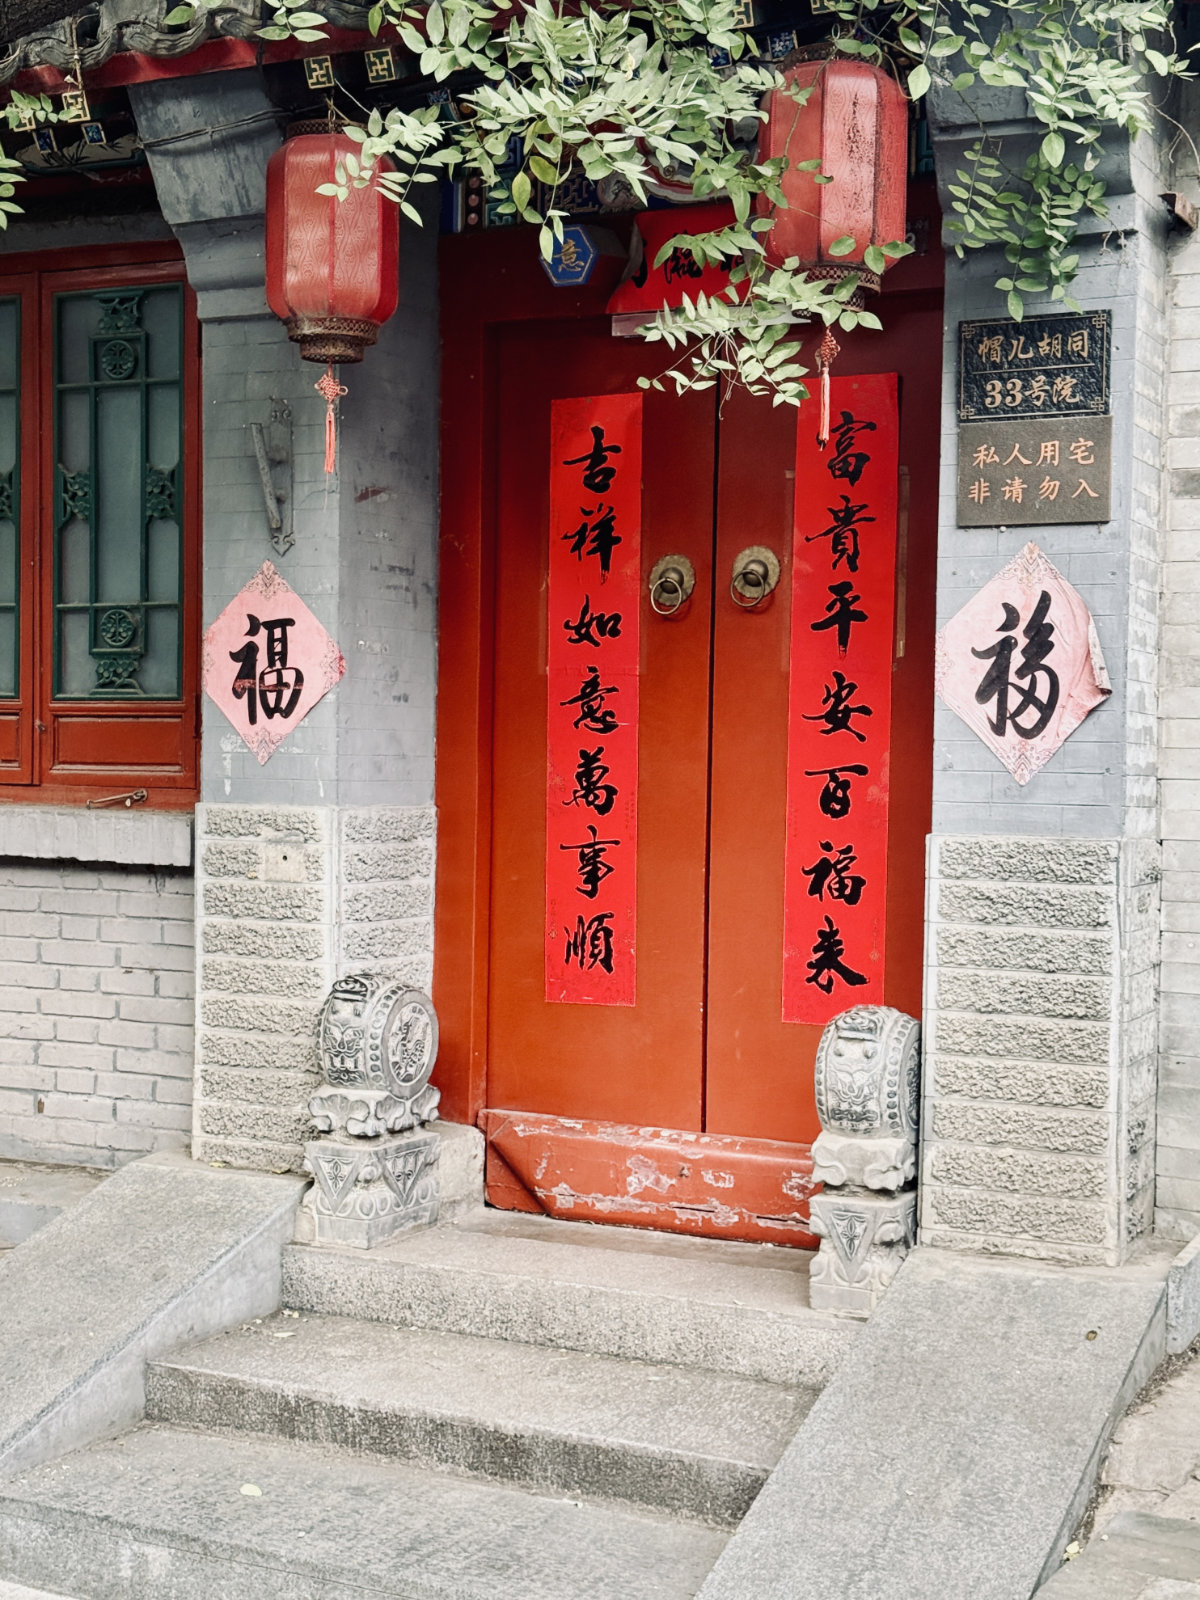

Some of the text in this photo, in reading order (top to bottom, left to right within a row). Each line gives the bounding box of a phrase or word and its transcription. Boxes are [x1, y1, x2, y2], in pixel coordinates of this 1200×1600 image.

[977, 329, 1089, 363] 帽儿胡同
[984, 375, 1081, 408] 33号院
[972, 437, 1095, 469] 私人用宅
[967, 476, 1099, 505] 非请勿入
[229, 613, 304, 725] 福
[972, 590, 1060, 740] 福
[560, 425, 622, 973] 吉祥如意萬事順
